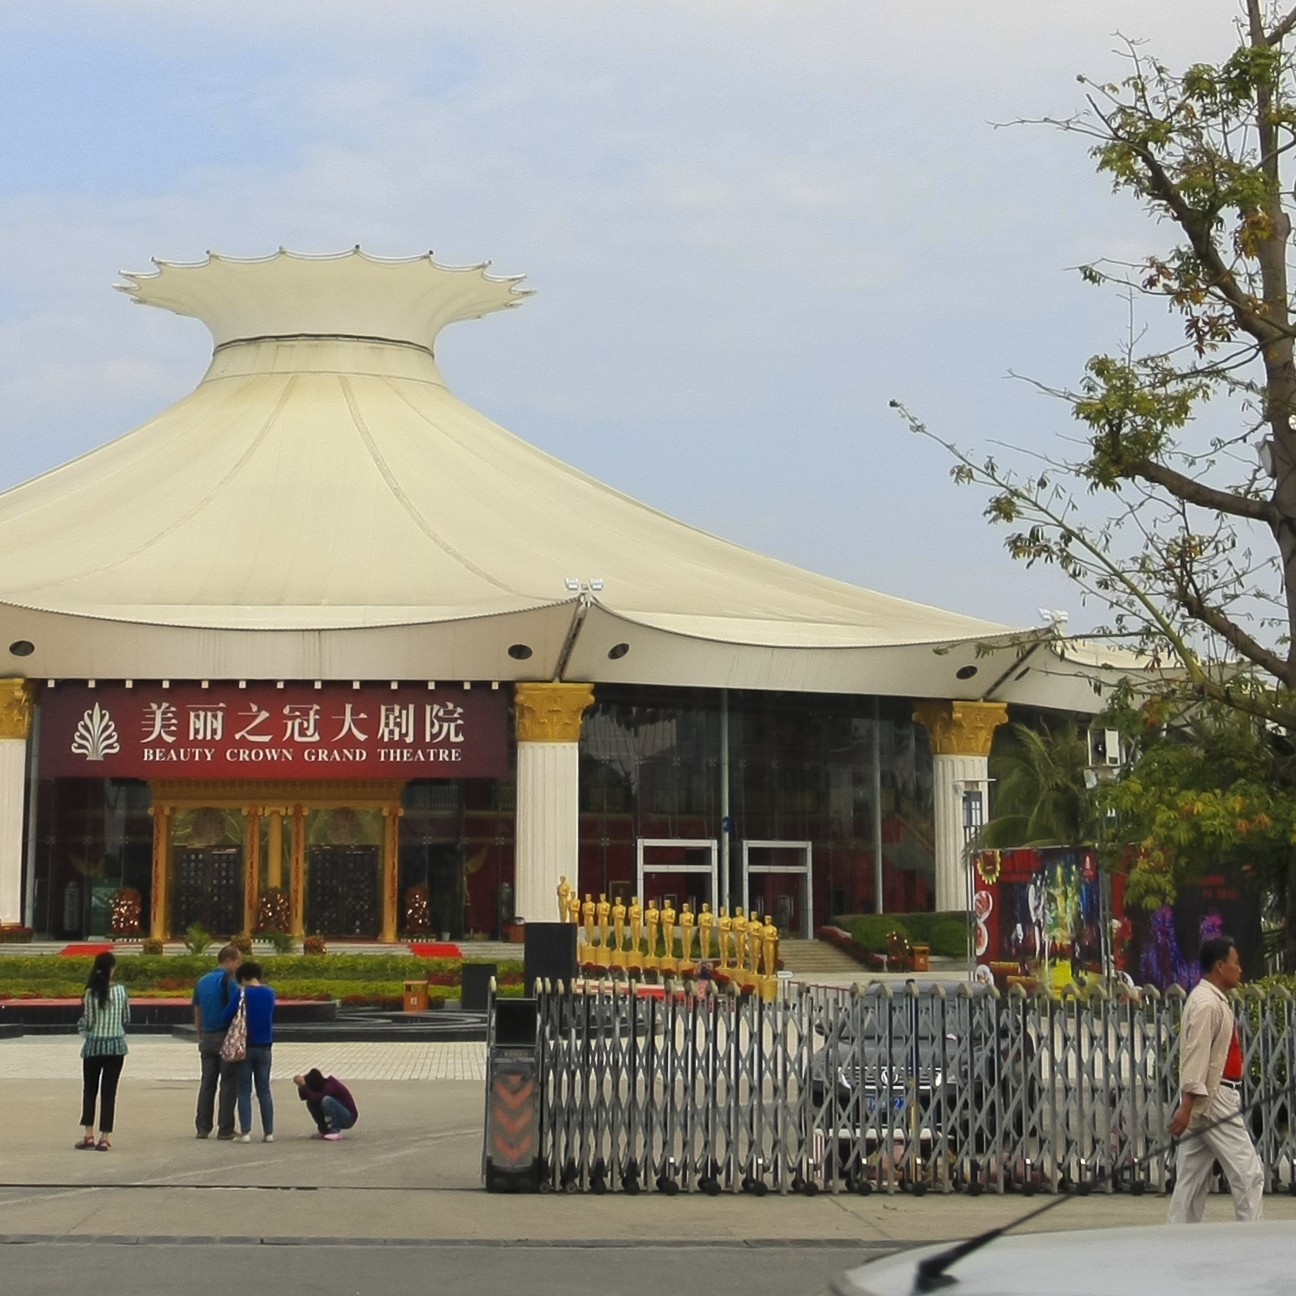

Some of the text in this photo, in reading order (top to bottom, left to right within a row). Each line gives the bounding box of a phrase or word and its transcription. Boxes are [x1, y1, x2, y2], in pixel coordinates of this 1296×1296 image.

[140, 701, 465, 743] 美丽之冠大剧院
[143, 748, 462, 762] BEAUTY CROWN GRAND THEATRE
